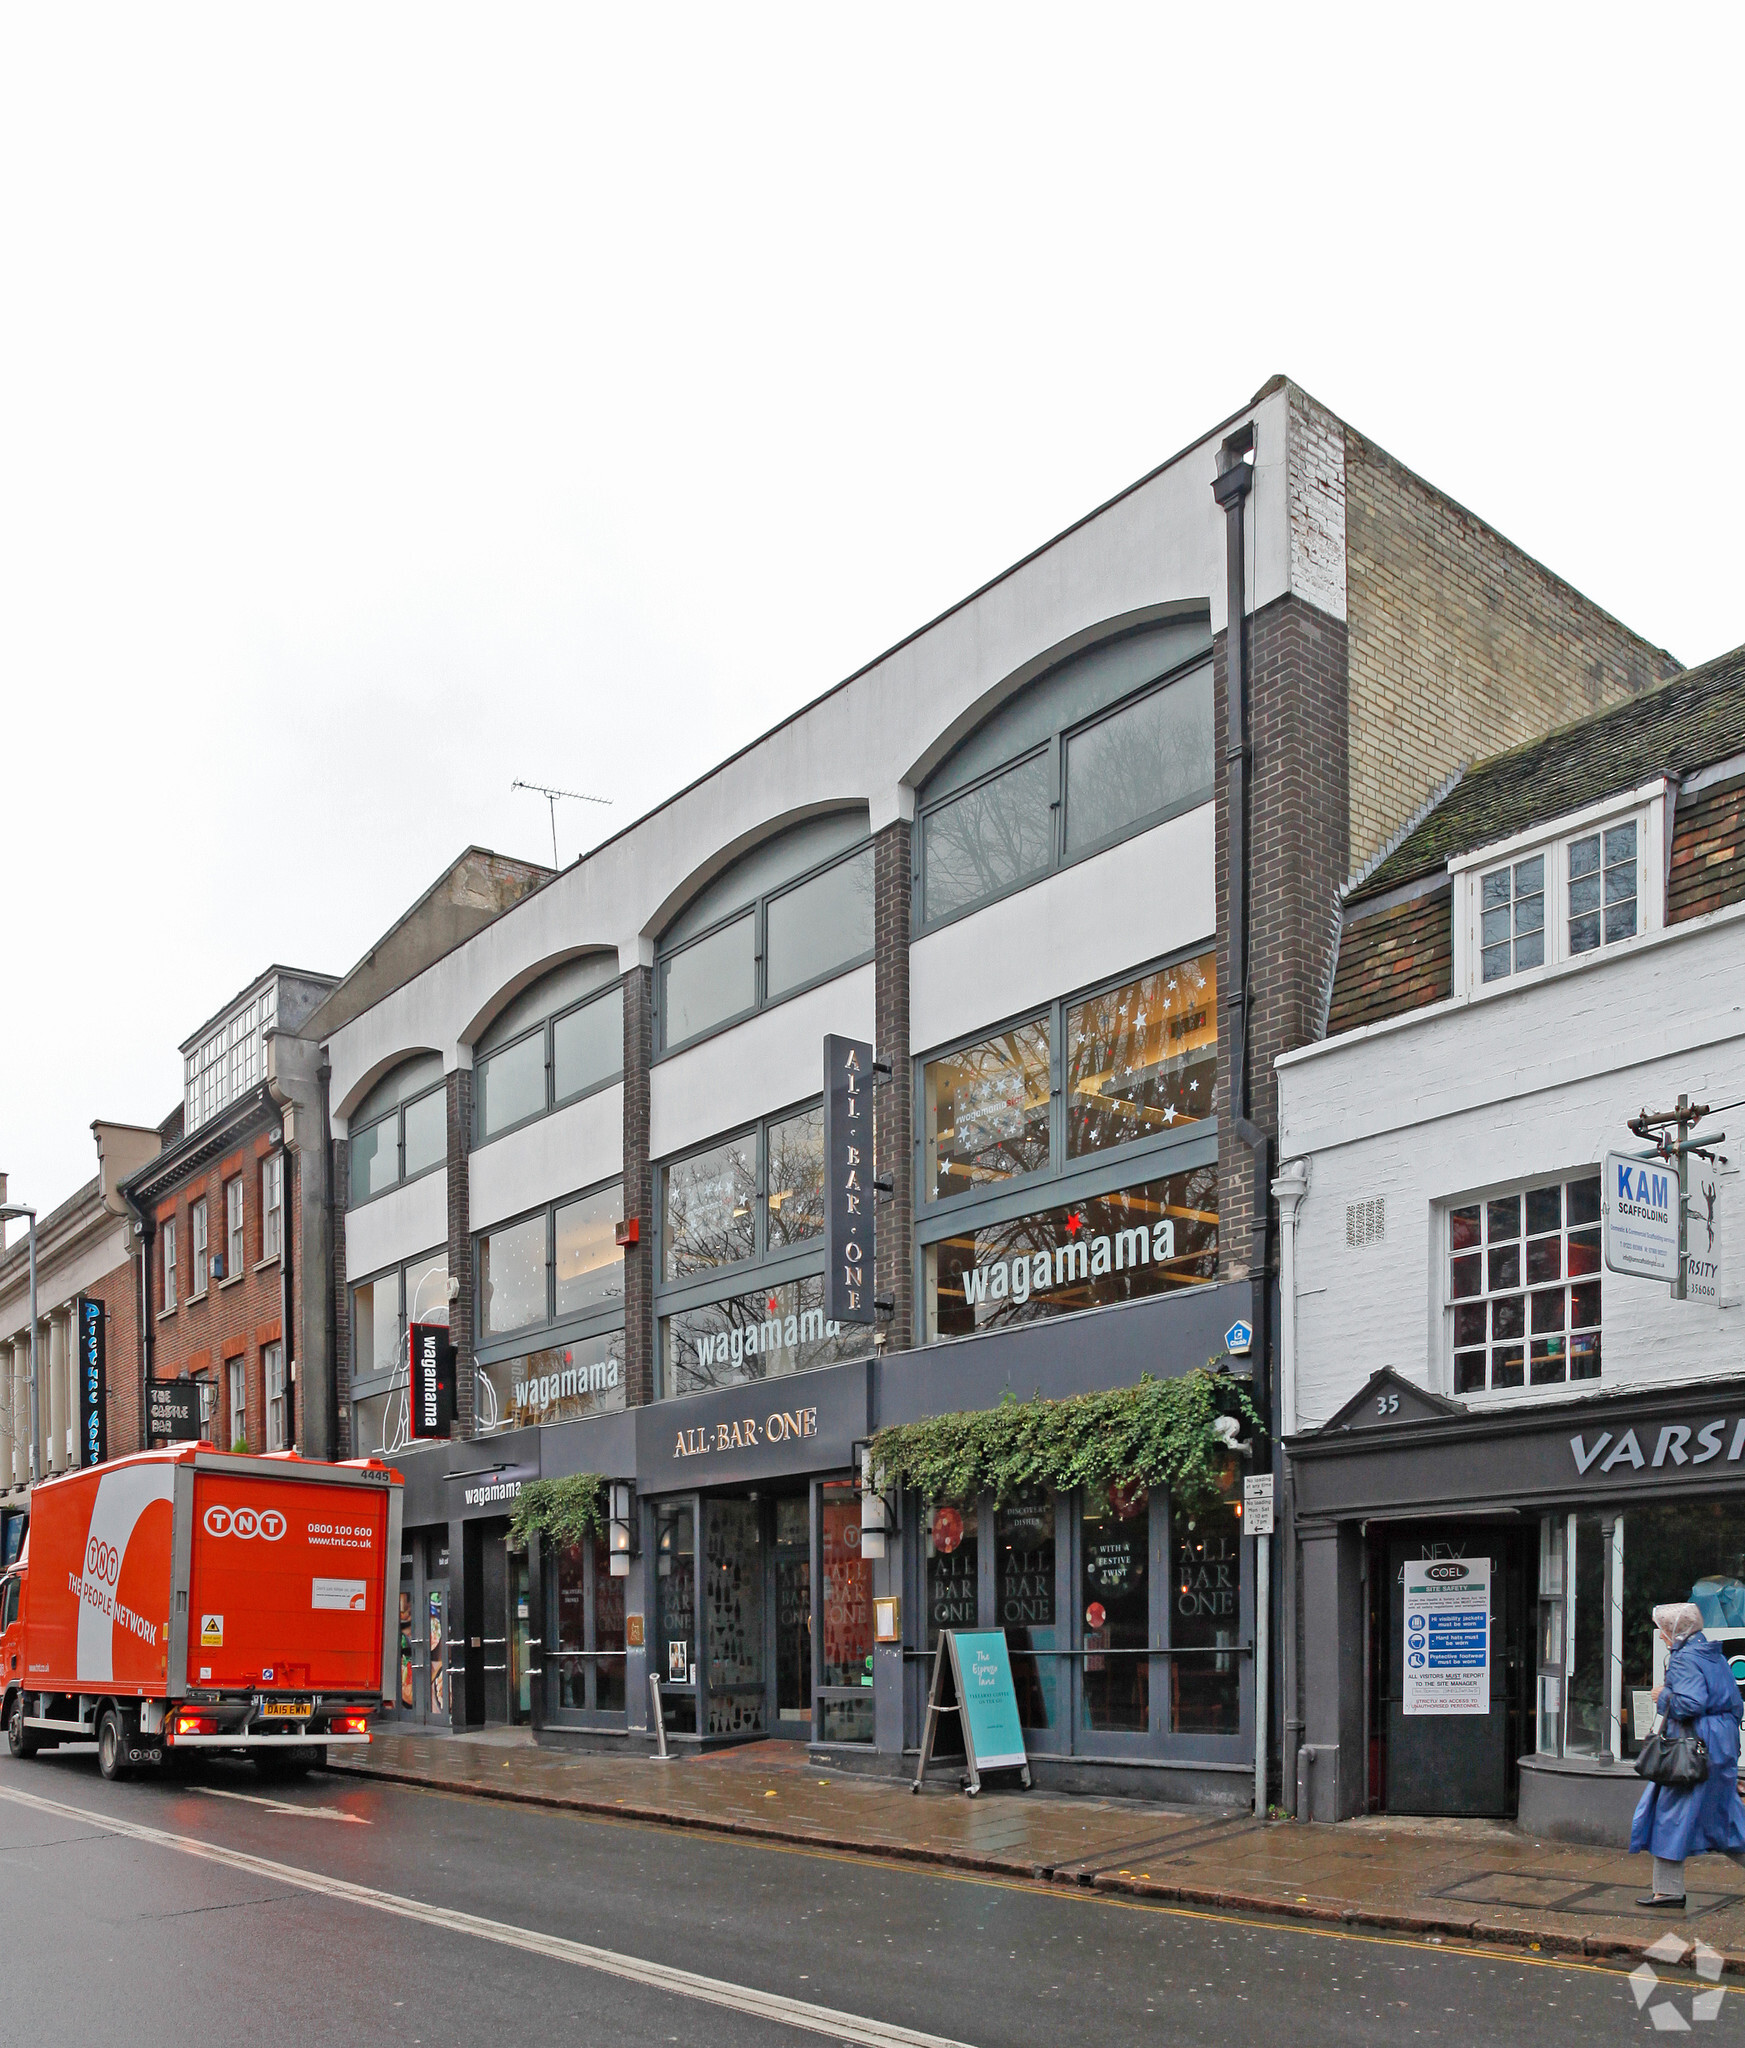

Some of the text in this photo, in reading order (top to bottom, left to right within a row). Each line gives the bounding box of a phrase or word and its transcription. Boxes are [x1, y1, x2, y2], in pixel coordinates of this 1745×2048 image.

[844, 1049, 862, 1311] ALL BAR ONE
[1617, 1163, 1668, 1210] KAM
[1618, 1202, 1668, 1224] SCAFFOLDING
[962, 1219, 1175, 1305] wagamama
[1688, 1259, 1718, 1279] RSITY
[697, 1308, 840, 1368] wagamama
[421, 1336, 437, 1428] wagamama
[515, 1359, 618, 1409] wagamama
[151, 1390, 171, 1403] THE
[1377, 1394, 1399, 1416] 35
[151, 1405, 189, 1418] CASTLE
[88, 1410, 100, 1465] hous
[152, 1420, 172, 1433] BAR
[673, 1407, 818, 1458] ALL BAR ONE
[1570, 1419, 1745, 1476] VARSI
[361, 1470, 389, 1482] 4445
[465, 1481, 522, 1507] wagamama
[208, 1509, 283, 1537] TNT
[308, 1523, 372, 1537] 0800 100 600
[308, 1536, 372, 1548] www.tnt.co.uk
[1099, 1544, 1121, 1553] WITH
[1179, 1537, 1234, 1563] ALL
[89, 1541, 117, 1582] TNT
[935, 1556, 974, 1576] ALL
[1005, 1551, 1050, 1574] ALL
[1098, 1556, 1131, 1566] FESTIVE
[1431, 1567, 1462, 1577] COEL
[1102, 1568, 1128, 1577] TWIST
[1179, 1564, 1233, 1589] BAR
[935, 1579, 974, 1599] BAR
[1005, 1575, 1049, 1597] BAR
[68, 1572, 157, 1646] THE PEOPLE NETWORK
[934, 1602, 974, 1622] ONE
[1004, 1599, 1050, 1622] ONE
[1178, 1590, 1233, 1616] ONE
[664, 1614, 691, 1629] ONE
[830, 1605, 867, 1624] ONE
[976, 1650, 990, 1661] The
[267, 1705, 307, 1714] DA15 EWN
[131, 1750, 161, 1760] TNT
